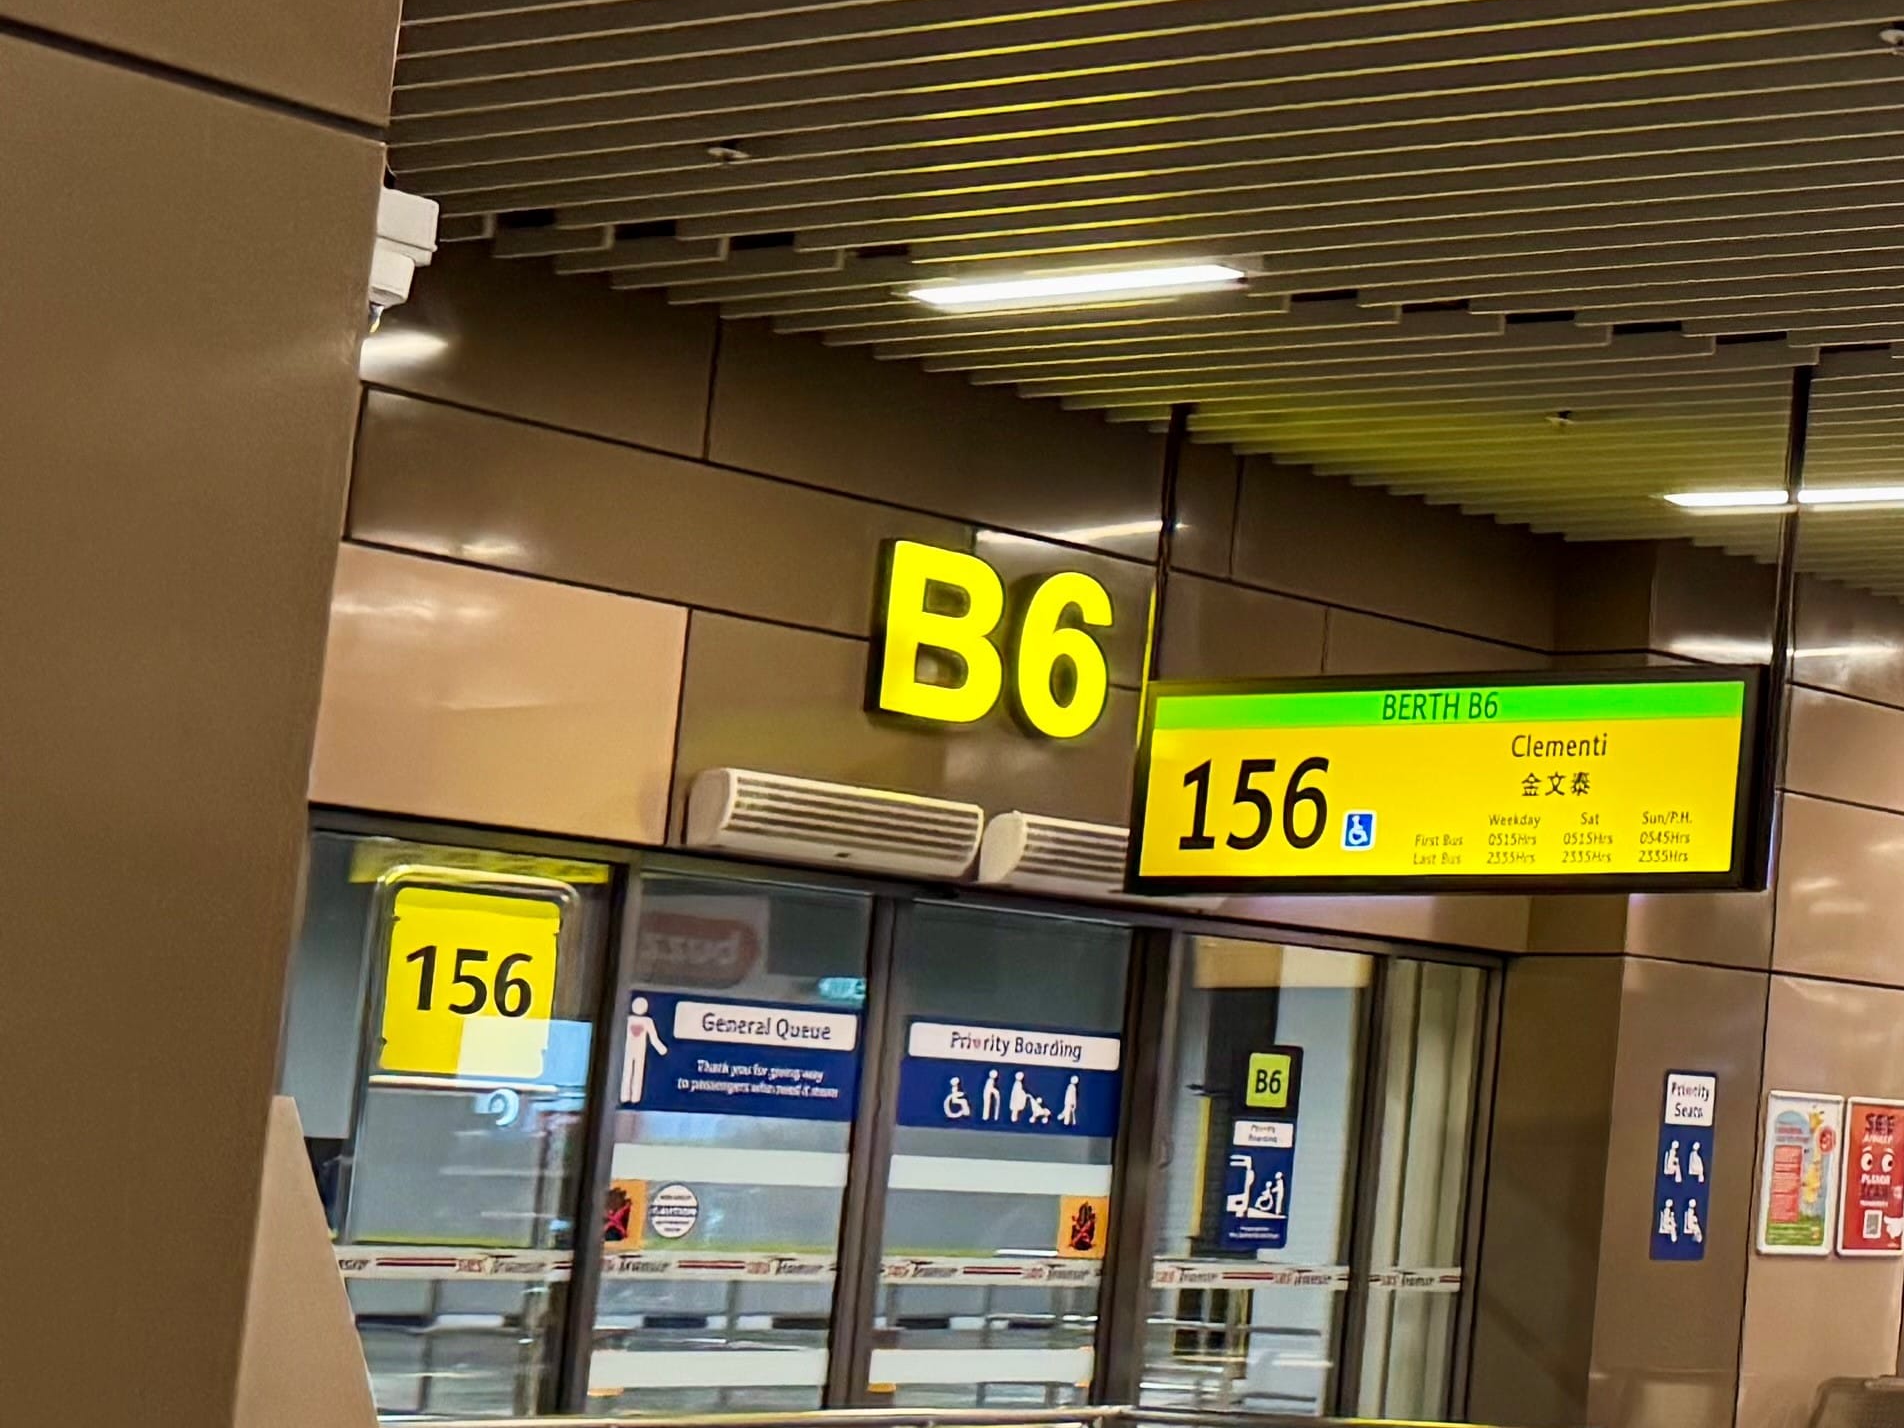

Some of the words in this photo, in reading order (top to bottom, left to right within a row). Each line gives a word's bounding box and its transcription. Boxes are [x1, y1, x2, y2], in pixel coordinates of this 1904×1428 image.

[880, 539, 1114, 739] B6
[1381, 690, 1461, 721] BERTH
[1467, 690, 1499, 720] B6
[1511, 733, 1608, 759] Clementi
[1520, 771, 1592, 798] 金文泰
[1177, 755, 1329, 852] 156
[1488, 814, 1541, 829] Weekday
[1580, 812, 1600, 826] Sat
[1414, 834, 1440, 847] First
[1443, 834, 1464, 847] Bus
[404, 943, 533, 1018] 156
[702, 1012, 771, 1035] General
[776, 1018, 832, 1040] Queue
[949, 1031, 1010, 1059] Priority
[1014, 1037, 1083, 1063] Boarding
[1255, 1068, 1282, 1095] B6
